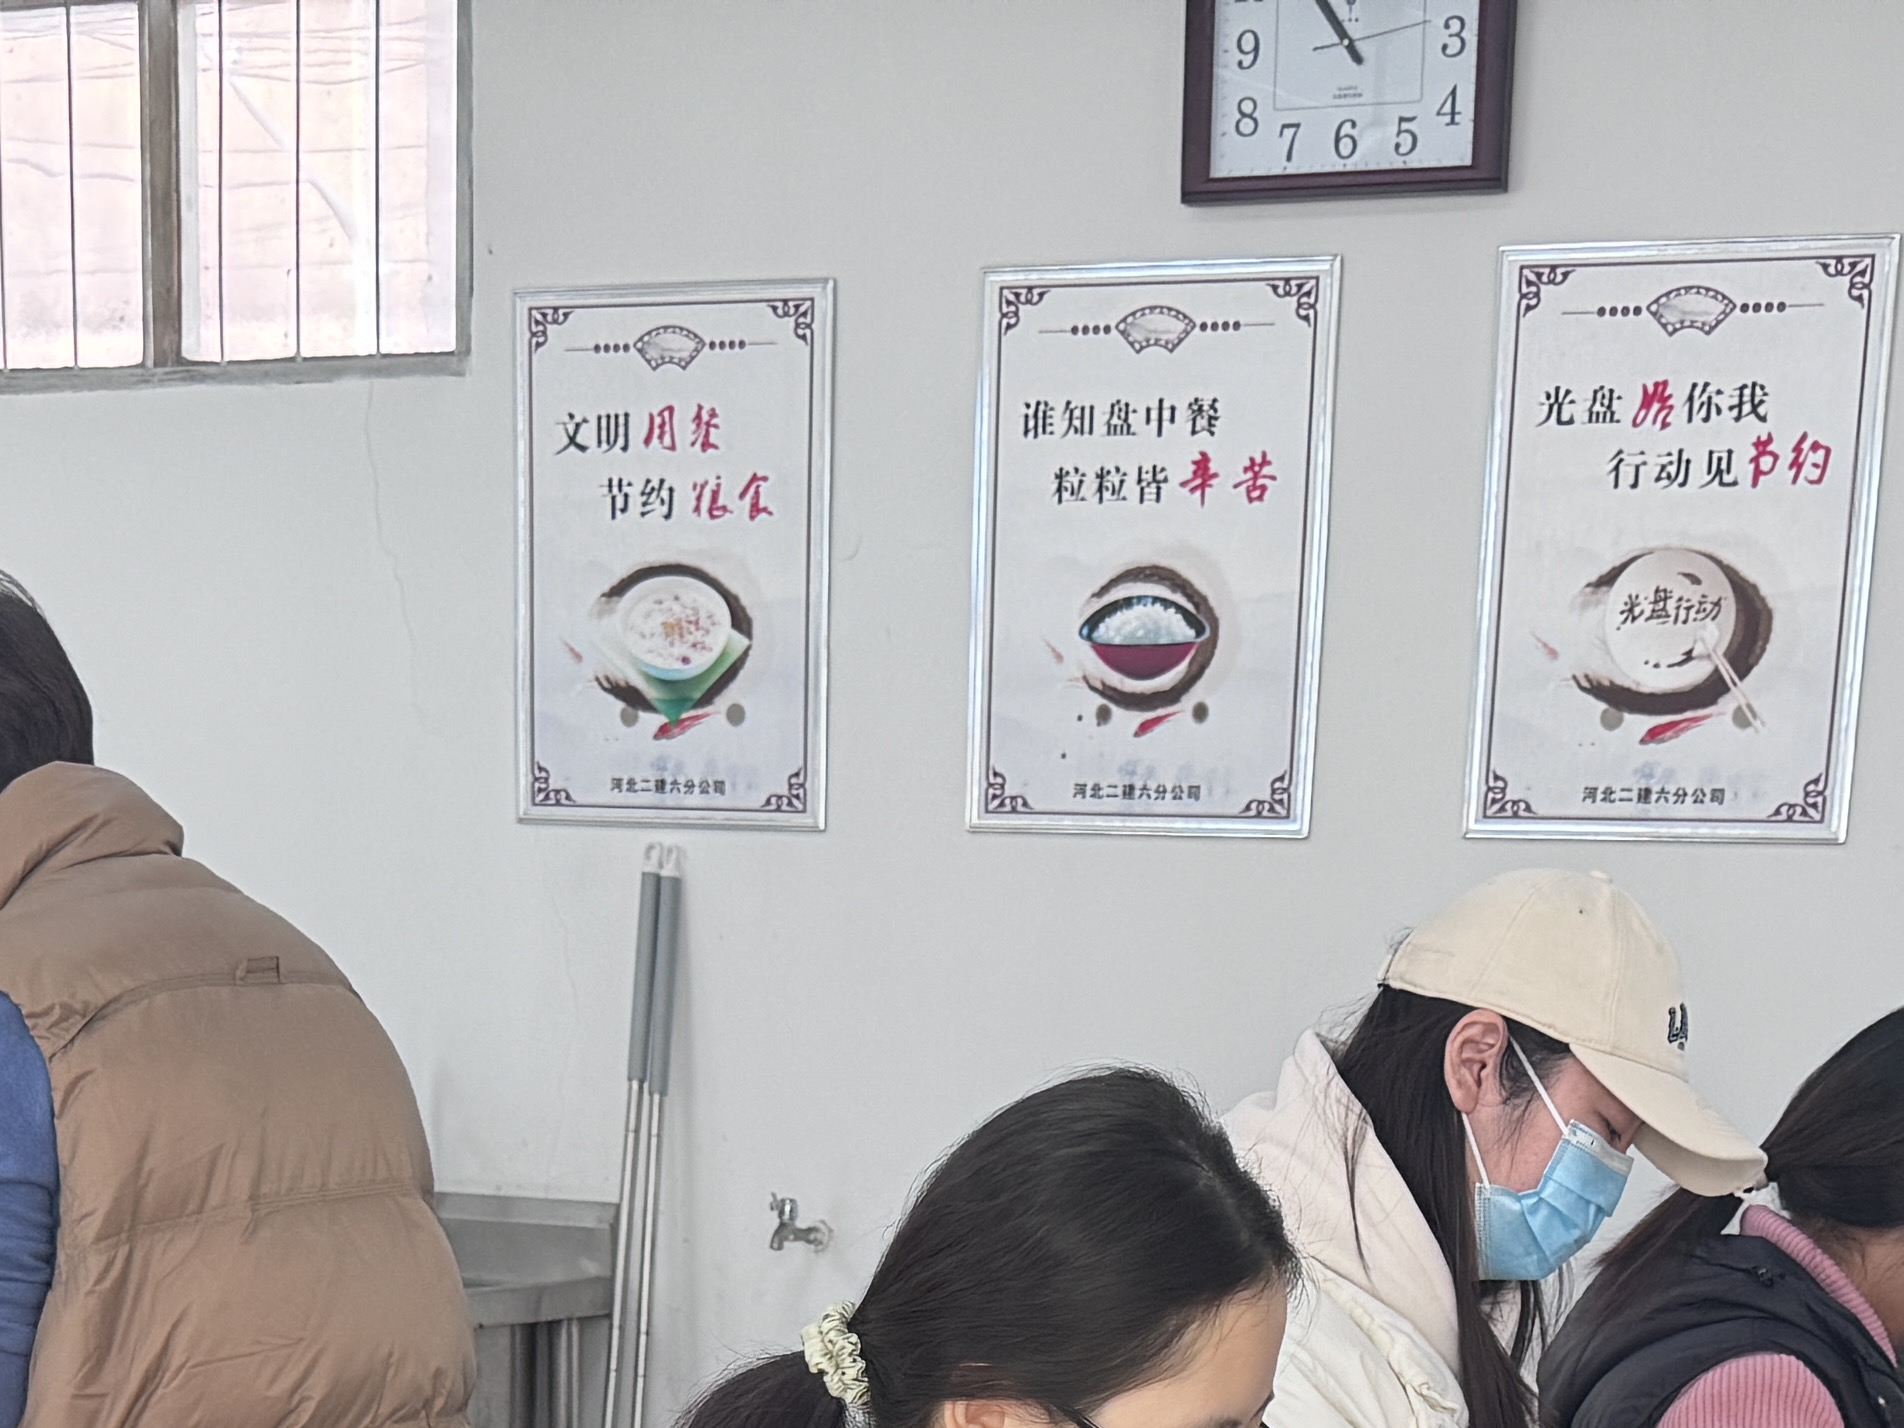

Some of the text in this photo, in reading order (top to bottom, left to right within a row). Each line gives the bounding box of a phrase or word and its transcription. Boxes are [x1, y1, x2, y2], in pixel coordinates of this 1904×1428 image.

[1237, 29, 1260, 70] 9
[1441, 15, 1466, 58] 3
[1234, 96, 1259, 138] 8
[1436, 84, 1462, 127] 4
[1279, 122, 1301, 163] 7
[1334, 118, 1358, 160] 6
[1394, 115, 1418, 157] 5
[554, 404, 721, 455] 文明用餐
[1021, 397, 1222, 440] 谁知盘中餐
[1051, 450, 1278, 508] 粒粒皆辛苦
[1606, 431, 1832, 490] 行动见节约
[599, 472, 775, 521] 节约粮食
[1616, 585, 1723, 628] 光盘行动
[610, 777, 726, 796] 河北二建六分公司
[1073, 782, 1202, 802] 河北二建六分公司
[1582, 786, 1726, 806] 河北二建六分公司
